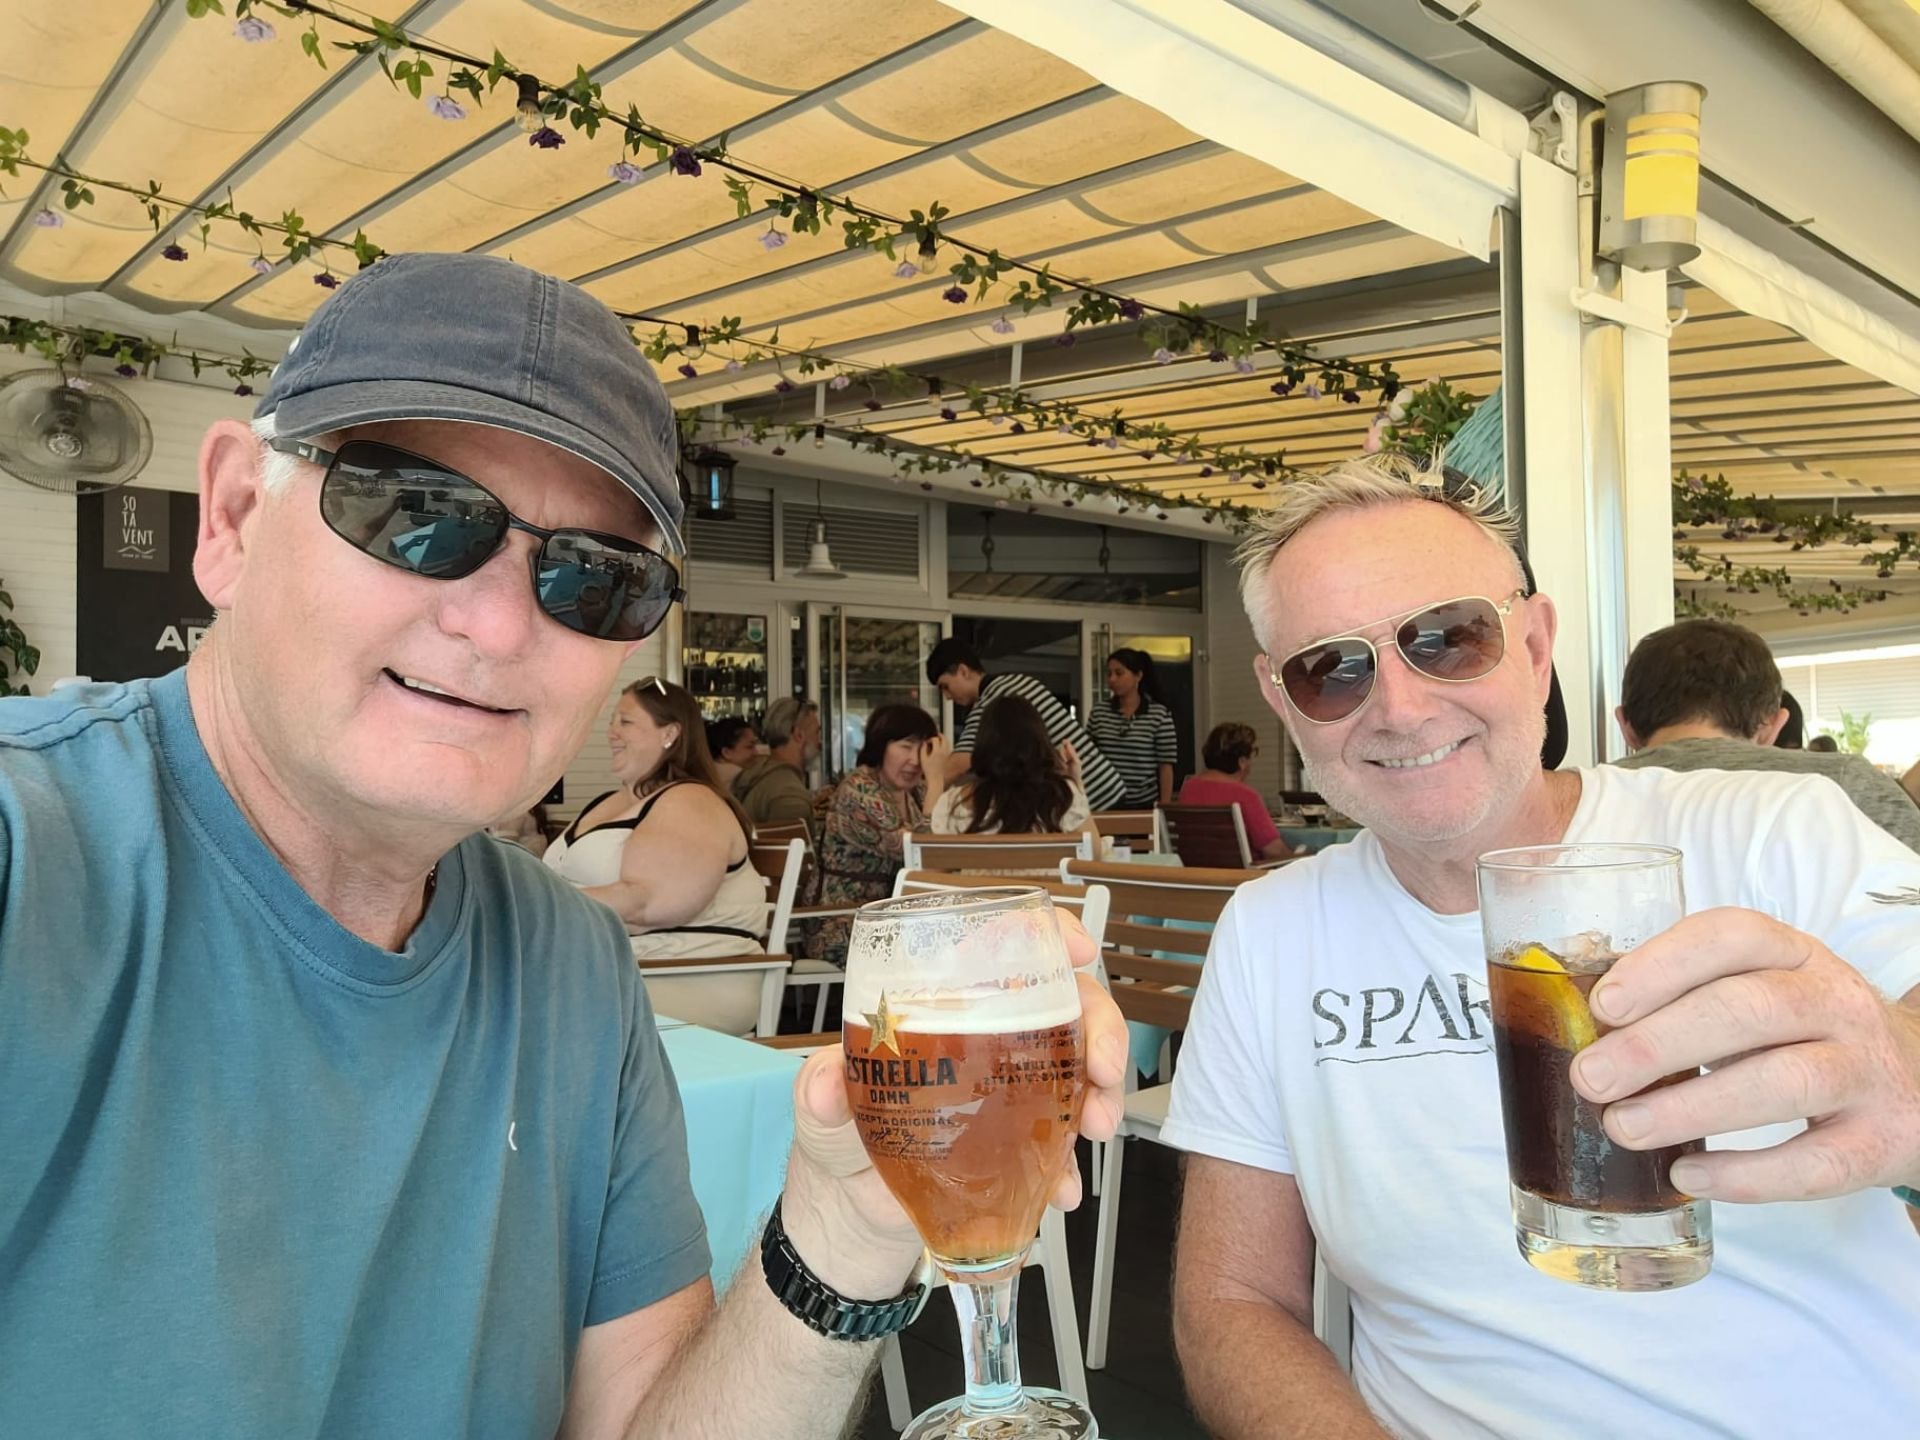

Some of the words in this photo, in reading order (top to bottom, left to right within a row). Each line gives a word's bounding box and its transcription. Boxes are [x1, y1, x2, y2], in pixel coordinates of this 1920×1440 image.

[123, 495, 137, 512] SO
[121, 512, 137, 528] TA
[121, 528, 154, 545] VENT
[846, 1055, 957, 1087] ESTRELLA
[870, 1089, 910, 1105] DAMM
